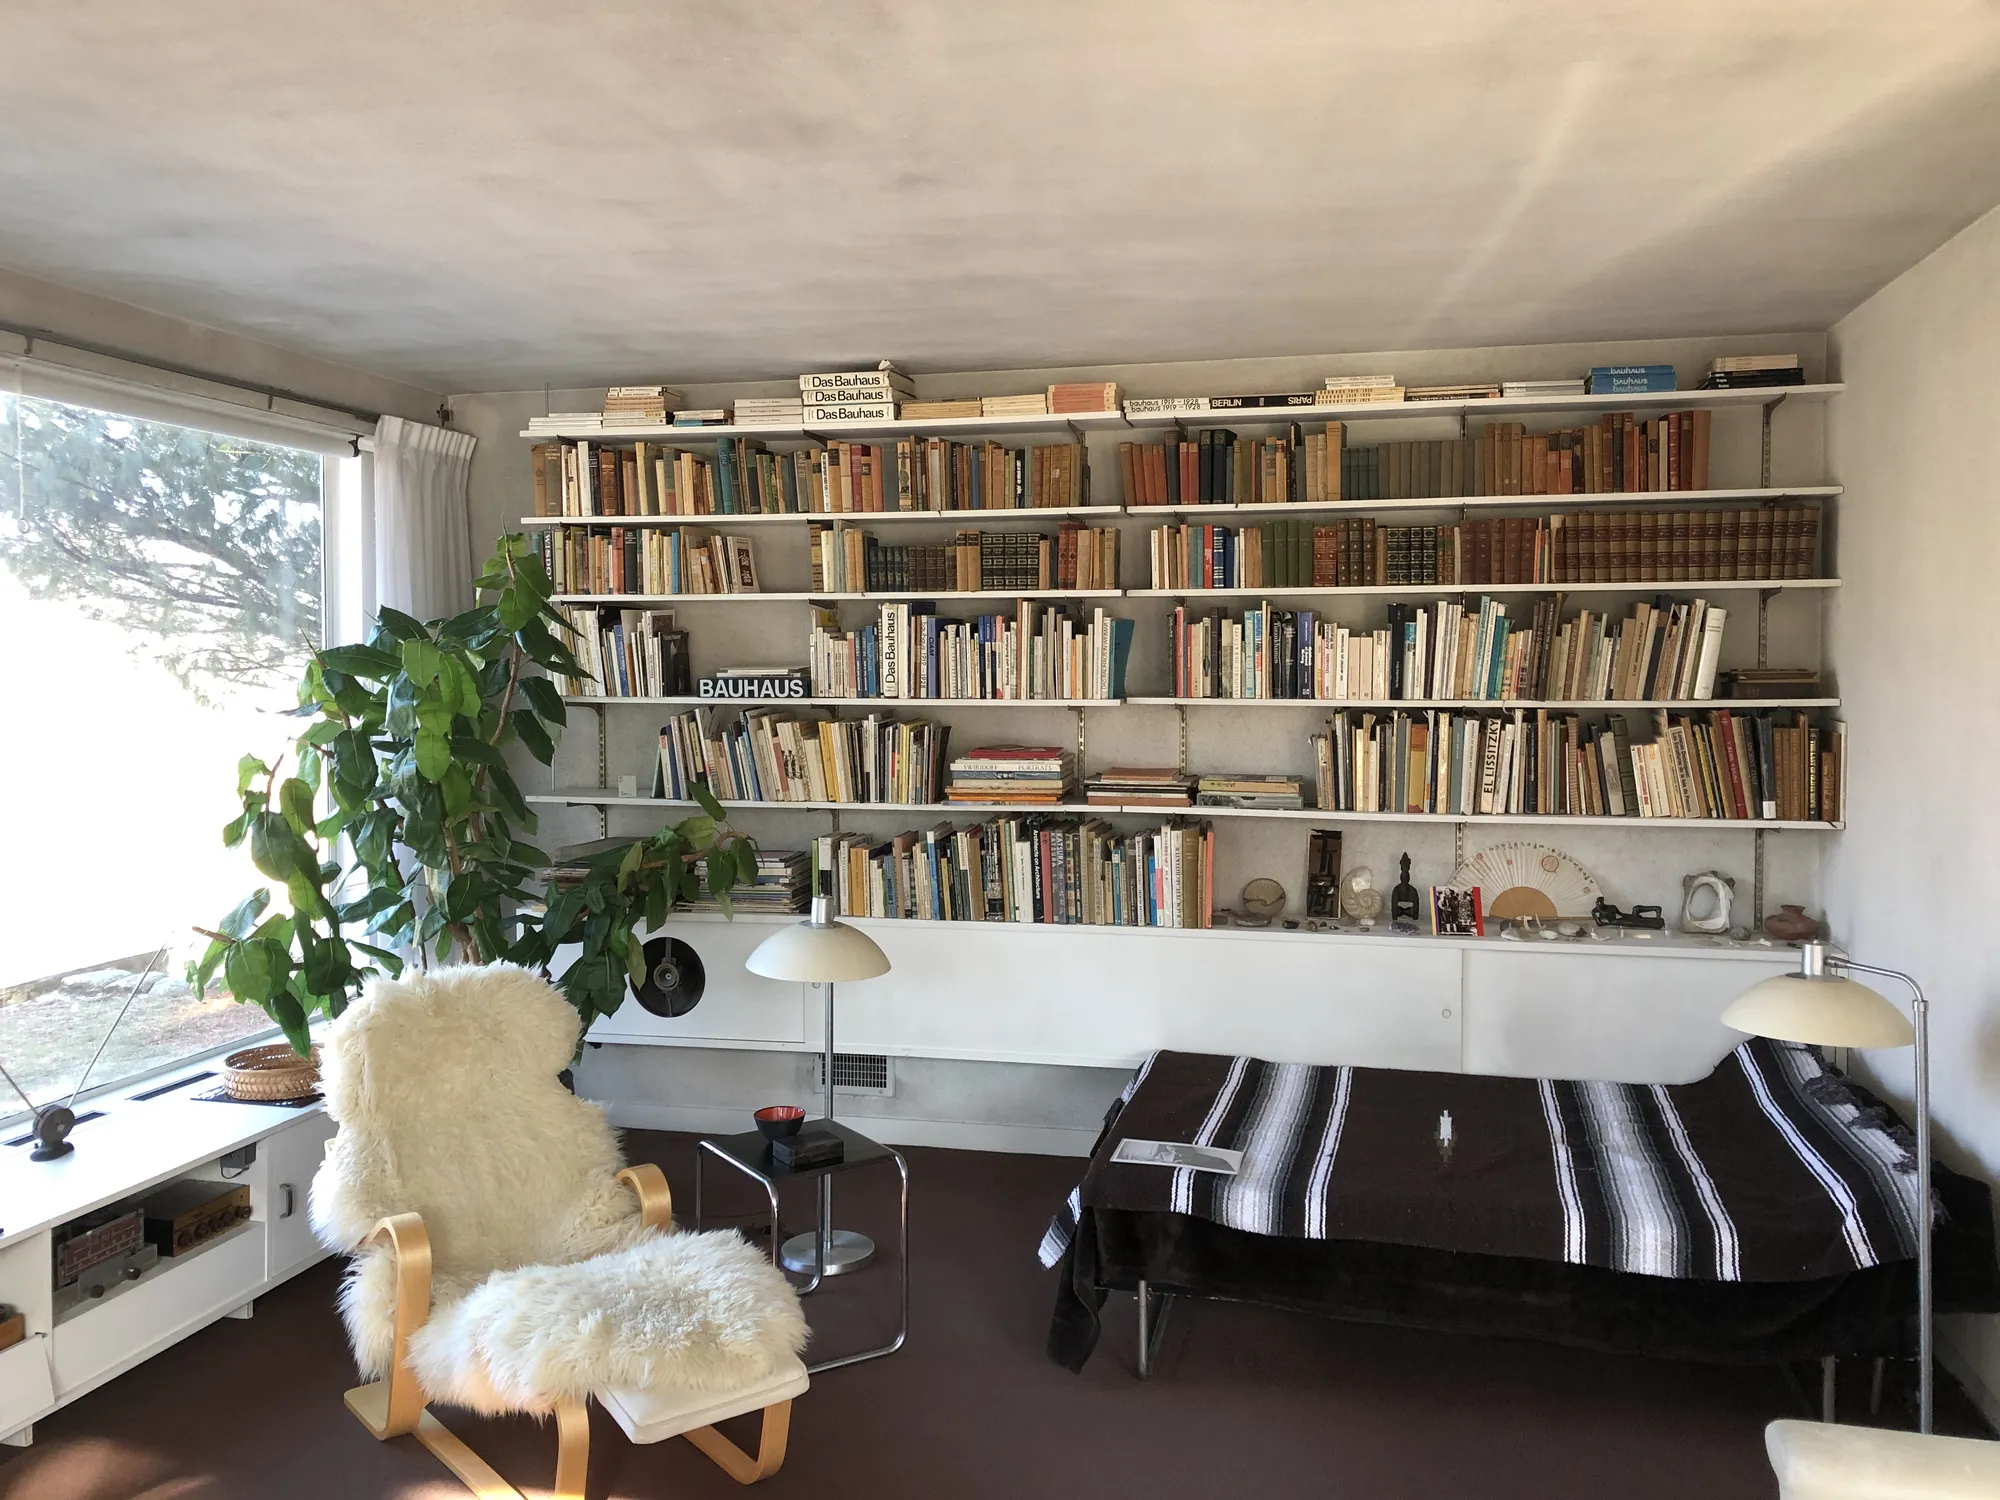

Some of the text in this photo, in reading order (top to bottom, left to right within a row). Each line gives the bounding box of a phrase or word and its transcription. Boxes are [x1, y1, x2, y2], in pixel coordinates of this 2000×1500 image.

[812, 375, 880, 388] Das Bauhaus
[815, 390, 884, 402] Das Bauhaus
[1288, 396, 1312, 405] PARIS
[1212, 398, 1242, 408] BERLIN
[816, 408, 884, 420] Das Bauhaus
[885, 612, 896, 684] Das Bauhaus
[699, 679, 804, 699] BAUHAUS
[1484, 720, 1498, 794] EL LISSITZKY
[1034, 858, 1039, 866] on
